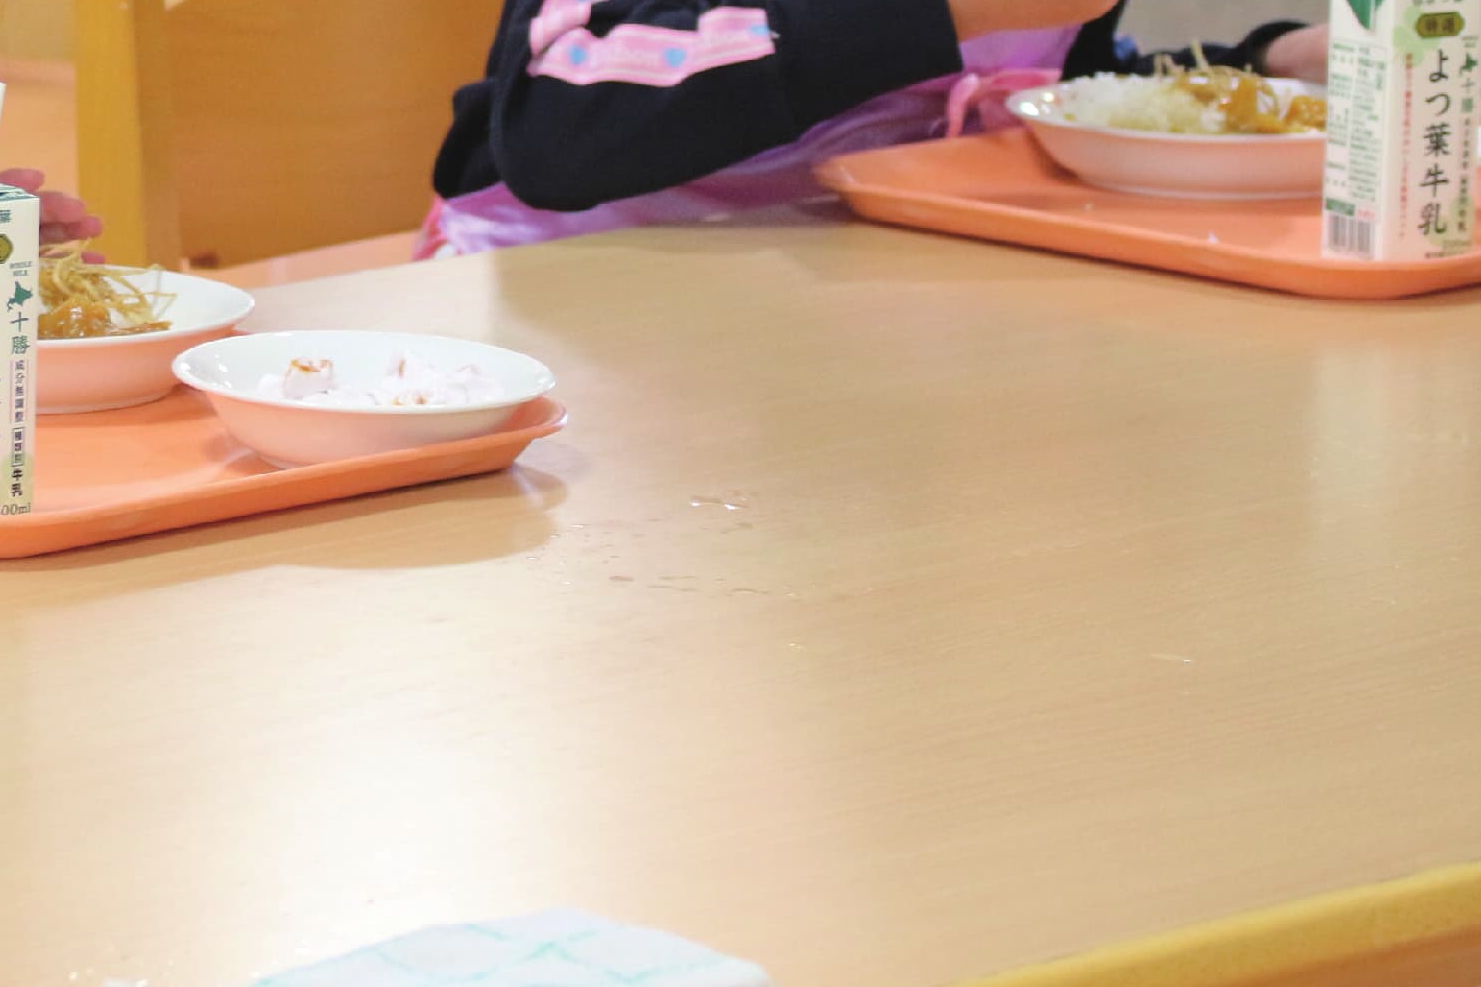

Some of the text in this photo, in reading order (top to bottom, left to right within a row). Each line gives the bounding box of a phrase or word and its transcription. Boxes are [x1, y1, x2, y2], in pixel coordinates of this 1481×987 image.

[1418, 48, 1451, 235] よつ葉牛乳
[10, 311, 30, 354] 十勝
